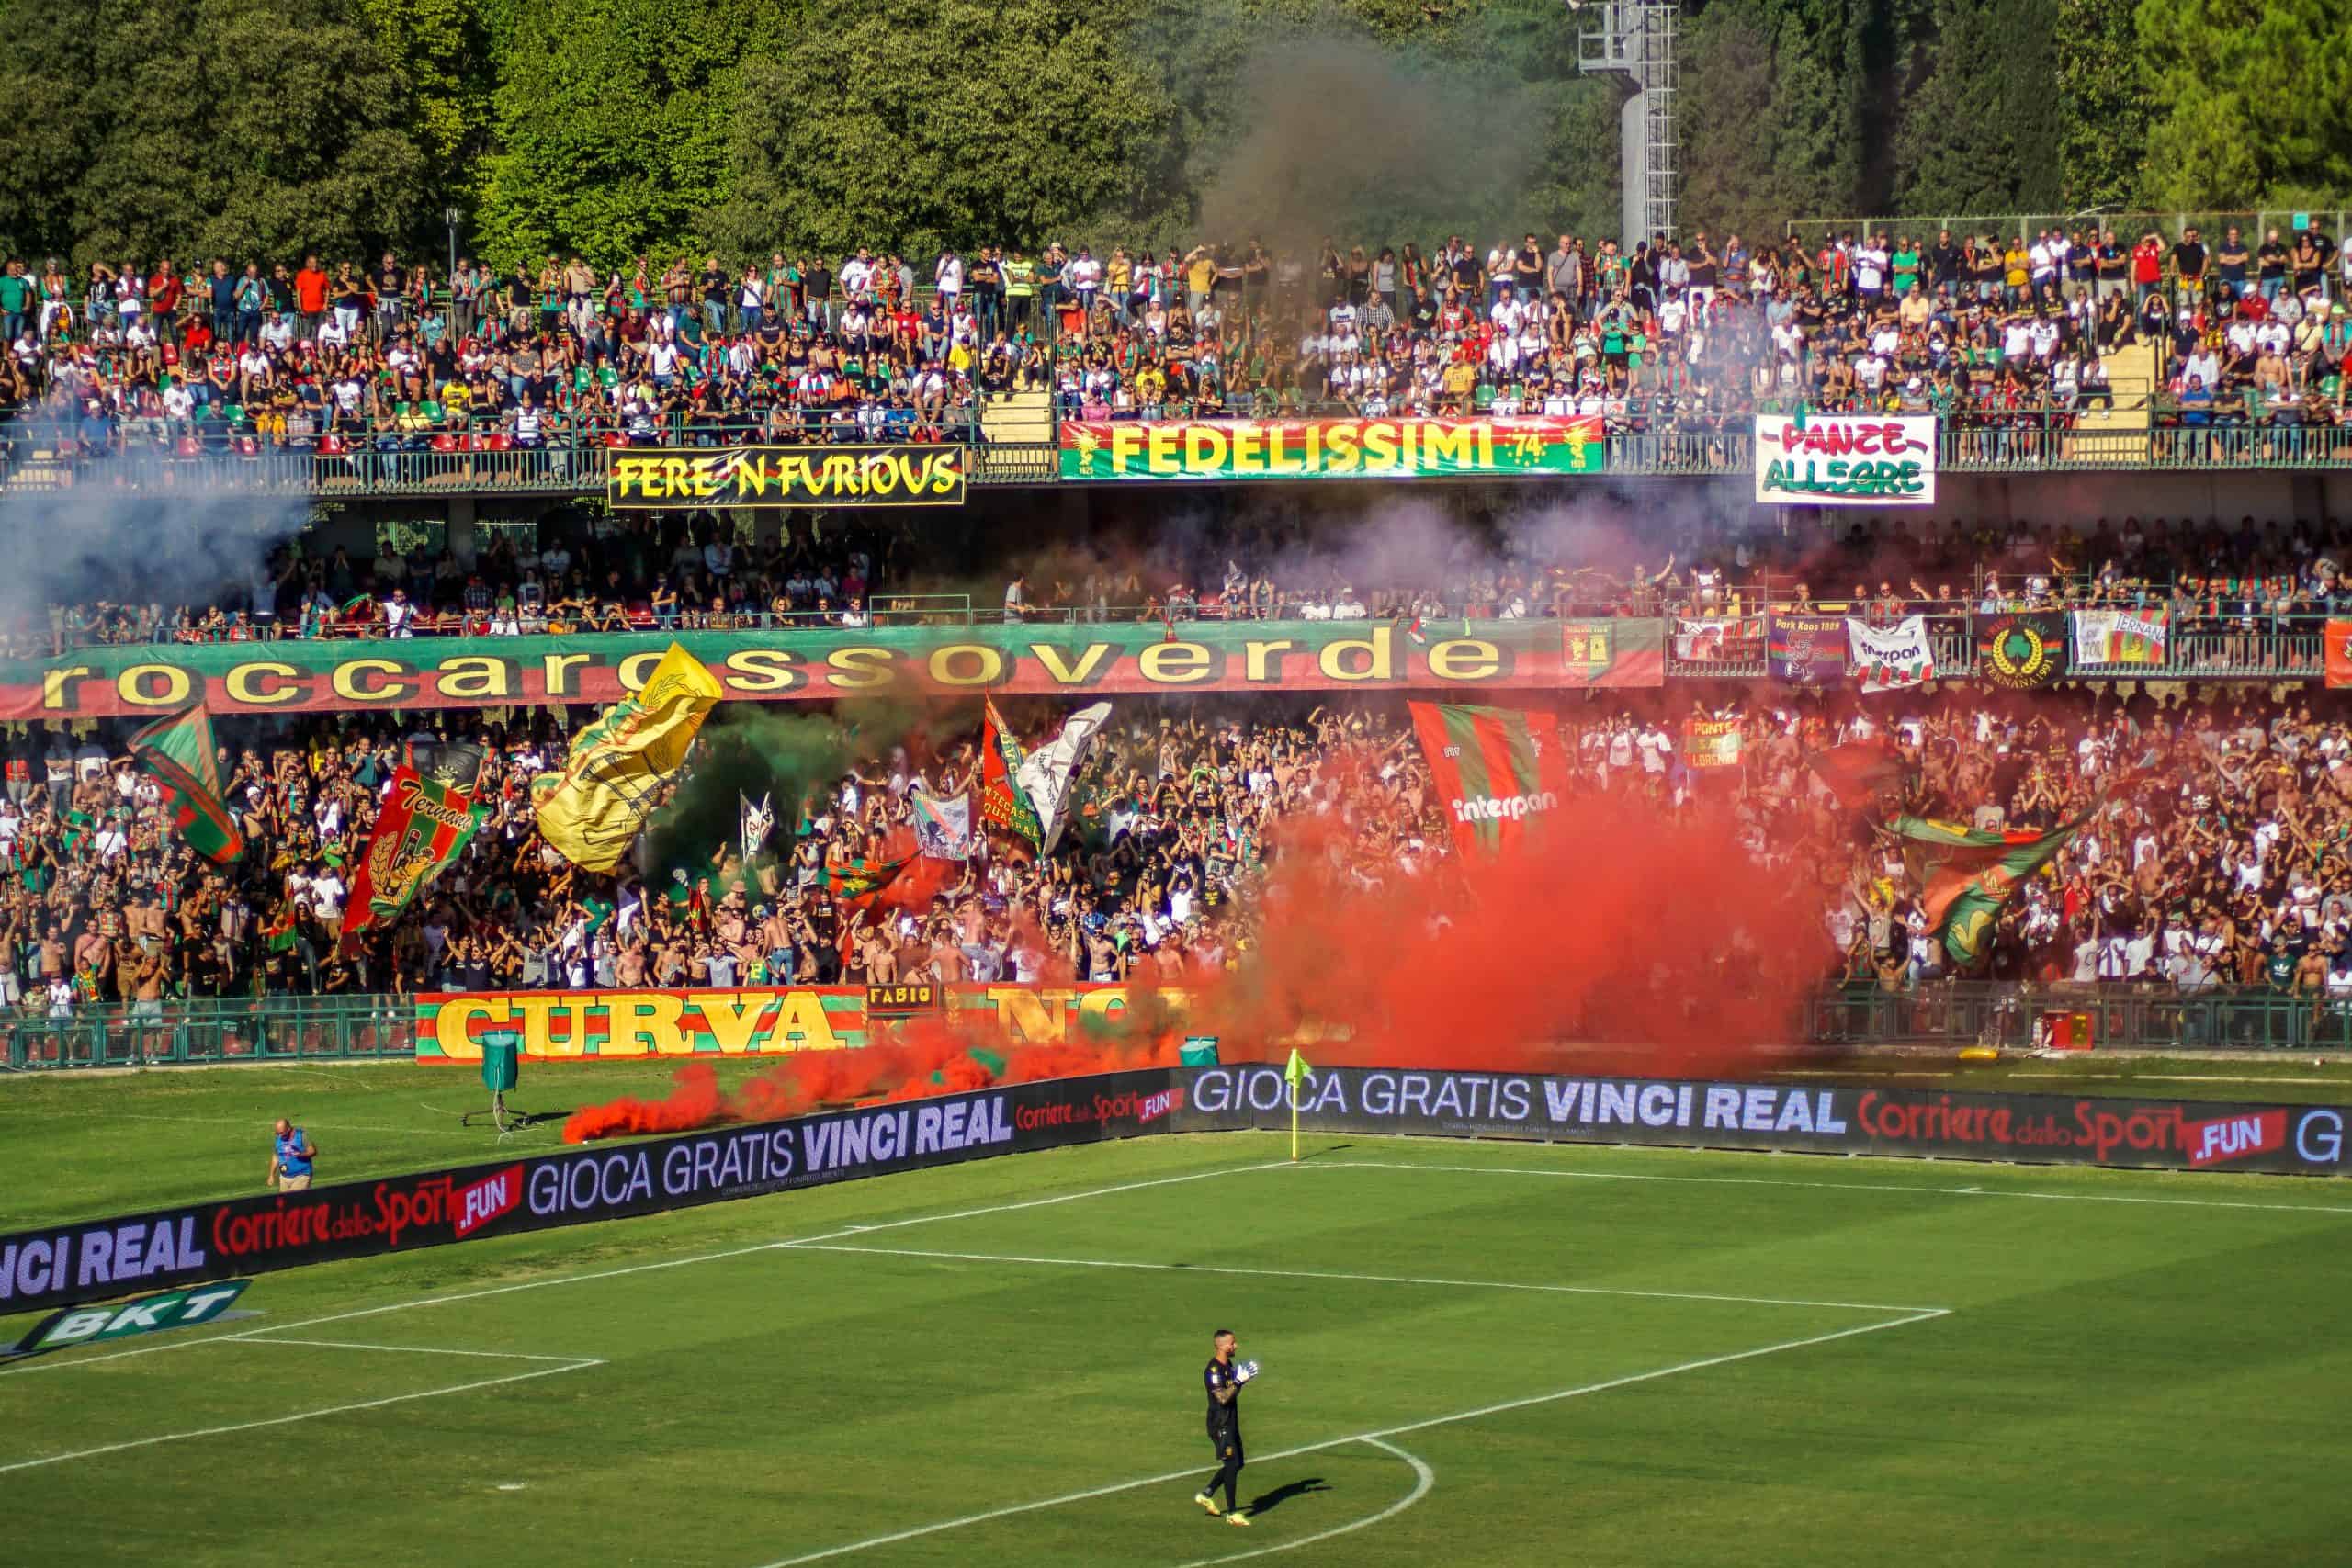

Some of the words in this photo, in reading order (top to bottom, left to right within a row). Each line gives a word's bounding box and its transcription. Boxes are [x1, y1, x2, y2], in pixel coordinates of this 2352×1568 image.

[1112, 423, 1494, 473] FEDELISSIMI
[1515, 433, 1543, 457] 74
[616, 457, 718, 497] FERE
[775, 454, 956, 496] FURIOUS
[1762, 458, 1925, 494] ALLEGRE
[1452, 792, 1559, 822] interpan
[869, 987, 931, 1004] FABIO
[435, 991, 848, 1059] CURVA
[1015, 1101, 1073, 1132] Corriere
[1193, 1069, 1349, 1113] GIOCA
[1362, 1074, 1531, 1121] GRATIS
[1544, 1080, 1693, 1128] VINCI
[1704, 1087, 1847, 1135] REAL
[1857, 1090, 2014, 1144] Corriere
[528, 1151, 652, 1215] GIOCA
[662, 1128, 794, 1195] GRATIS
[802, 1110, 910, 1172] VINCI
[915, 1096, 1012, 1155] REAL
[78, 1216, 205, 1286] REAL
[213, 1197, 331, 1257] Corriere
[45, 1290, 236, 1343] BKT
